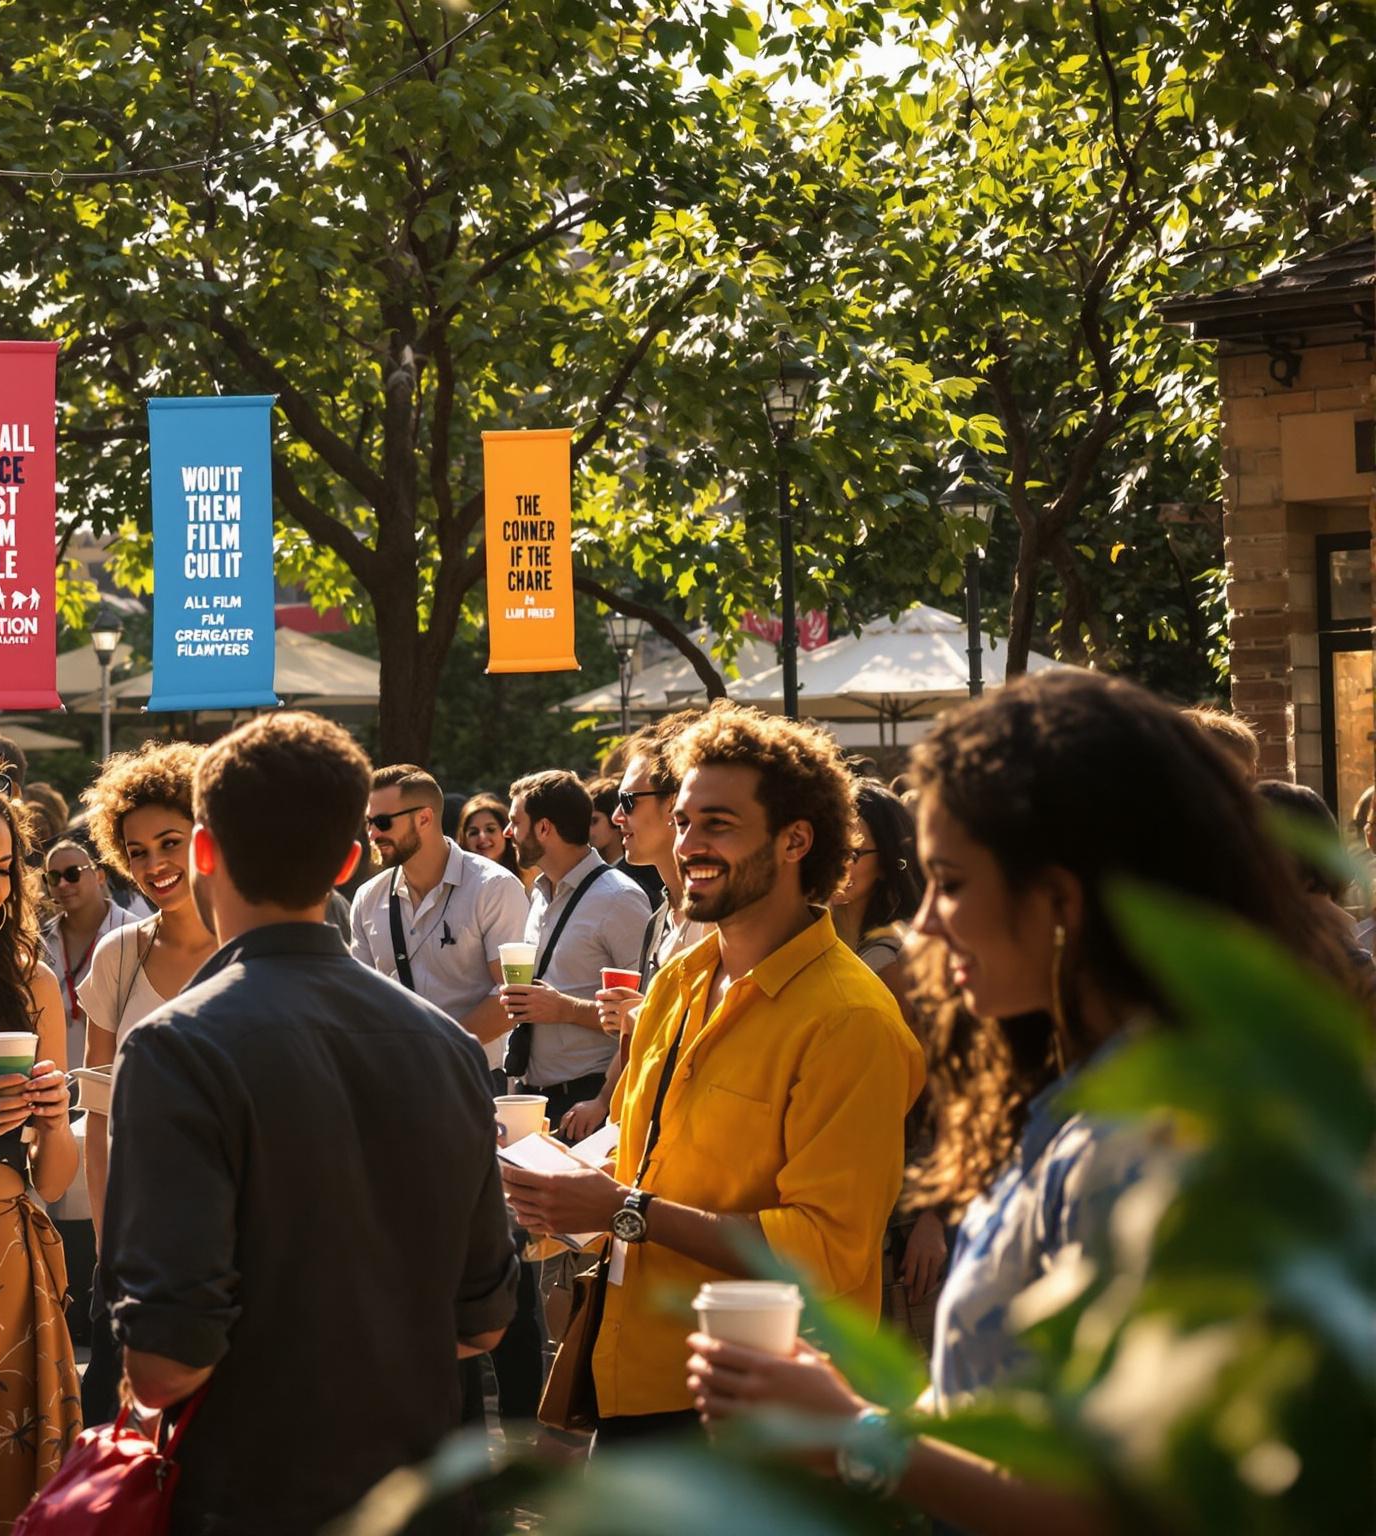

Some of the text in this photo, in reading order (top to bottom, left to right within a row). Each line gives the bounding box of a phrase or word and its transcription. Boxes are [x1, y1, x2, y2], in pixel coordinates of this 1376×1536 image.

[0, 423, 34, 452] ALL
[186, 495, 241, 522] THEM
[516, 495, 541, 516] THE
[187, 524, 240, 550] FILM
[224, 553, 242, 579] IT
[528, 546, 551, 566] THE
[508, 570, 552, 591] CHARE
[184, 596, 241, 609] ALL FILM
